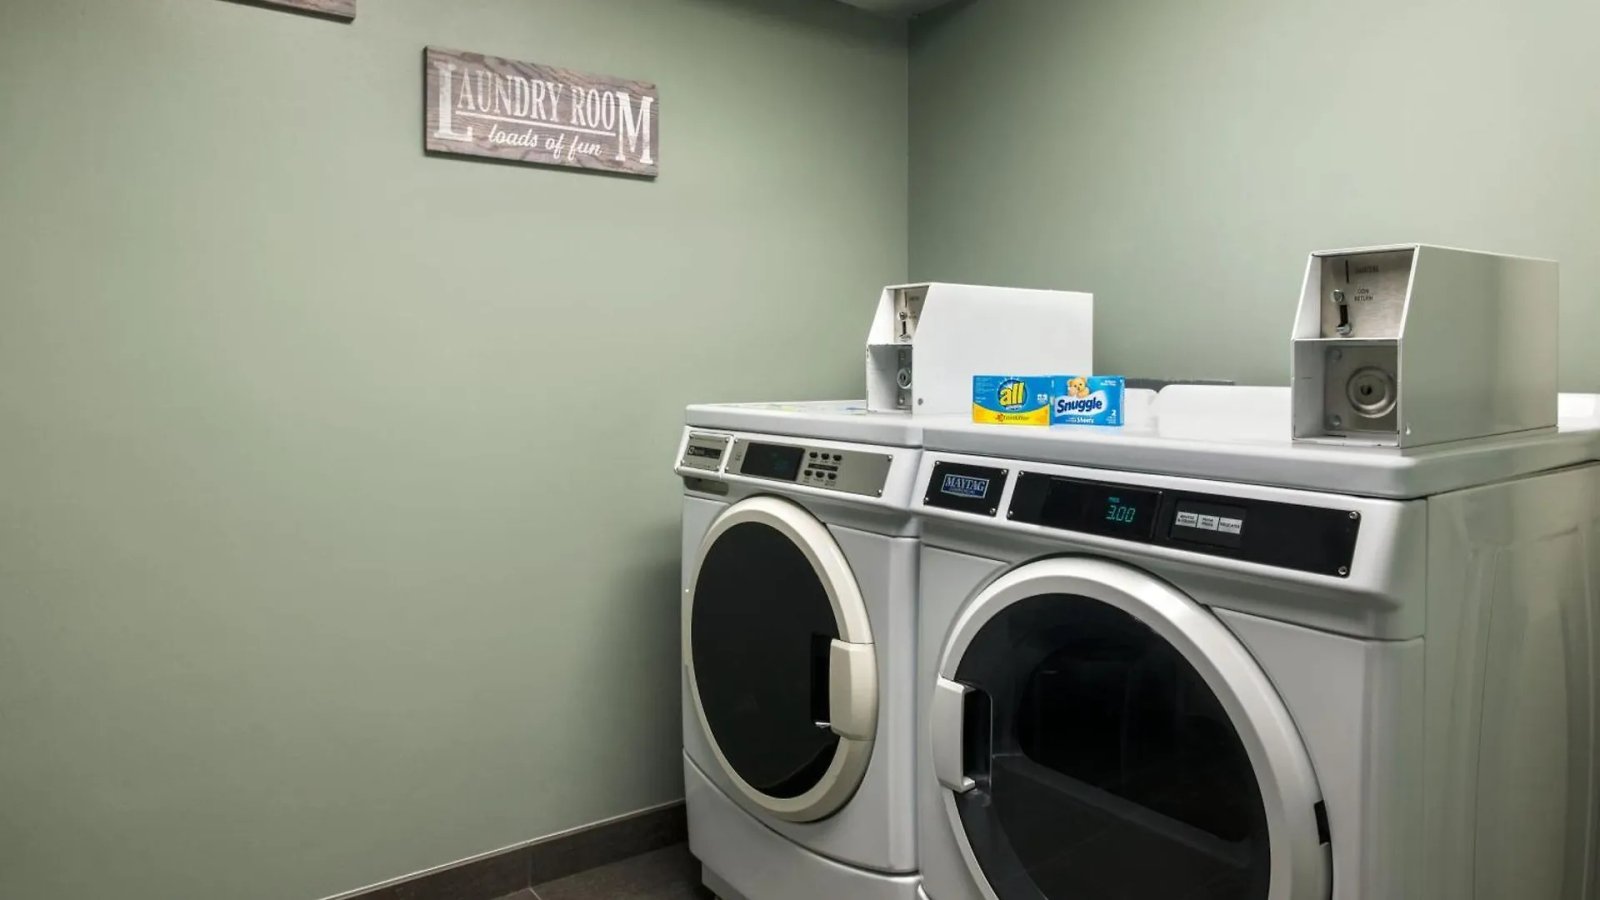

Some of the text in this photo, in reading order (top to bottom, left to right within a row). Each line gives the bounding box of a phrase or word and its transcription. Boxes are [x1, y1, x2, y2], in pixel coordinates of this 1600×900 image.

[433, 61, 655, 165] LAUNDRY ROOM
[488, 123, 603, 161] loads of fun
[999, 383, 1025, 406] all
[1056, 397, 1103, 414] Snuggle
[945, 477, 985, 491] MAYTAG
[1106, 505, 1136, 523] 3.00
